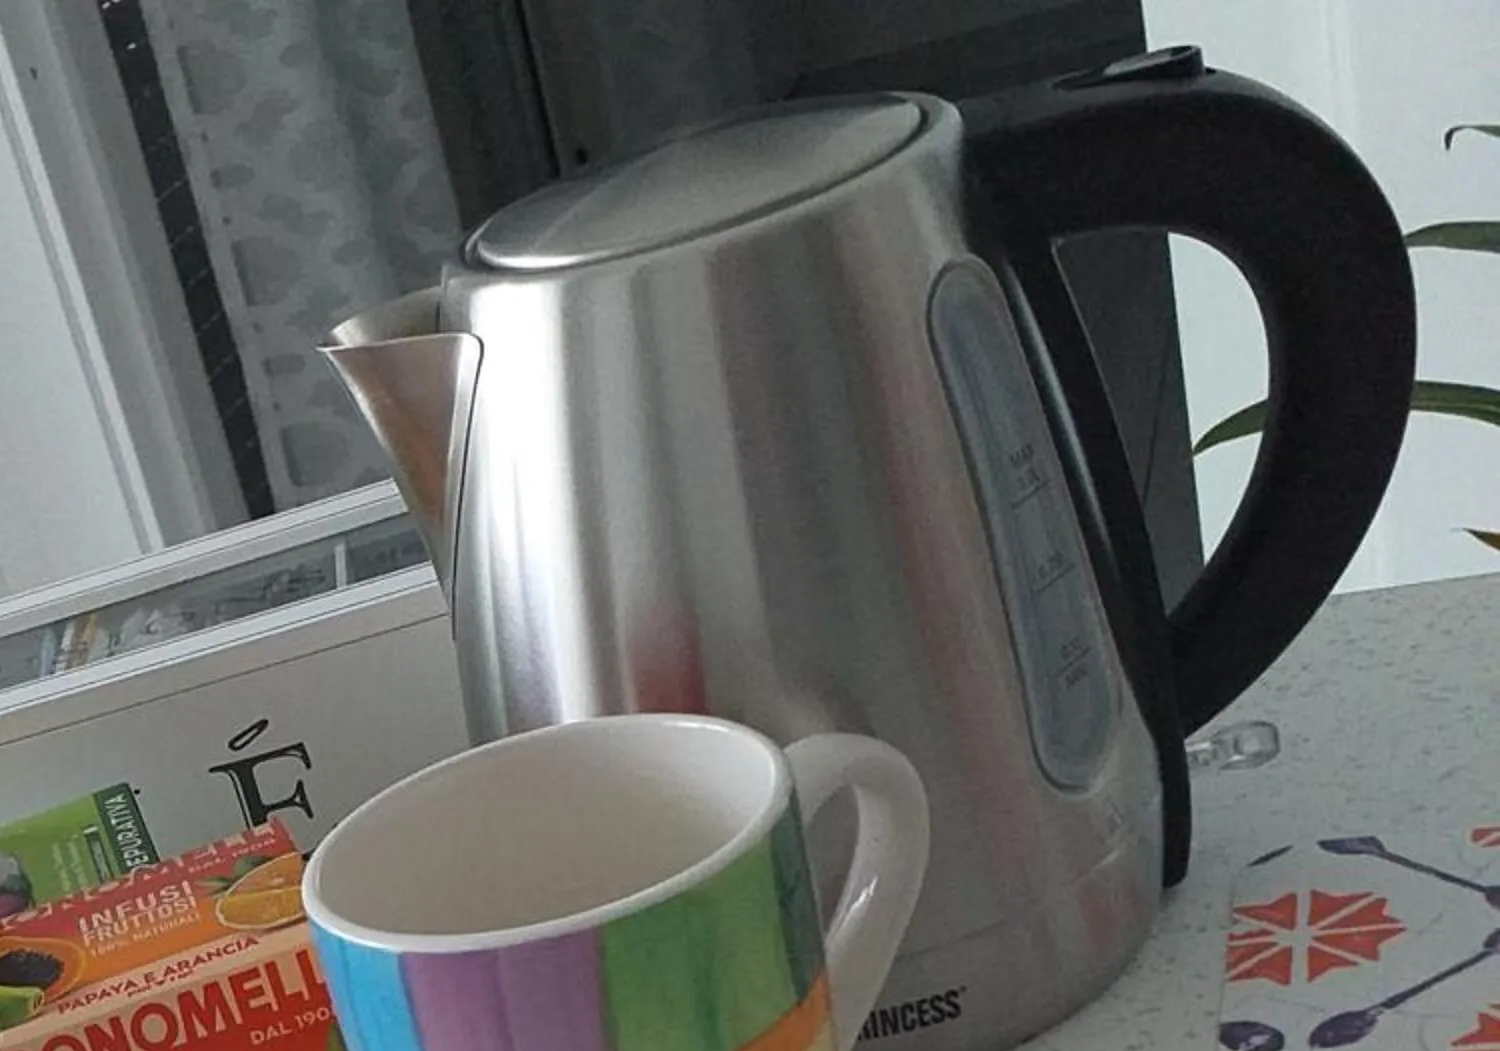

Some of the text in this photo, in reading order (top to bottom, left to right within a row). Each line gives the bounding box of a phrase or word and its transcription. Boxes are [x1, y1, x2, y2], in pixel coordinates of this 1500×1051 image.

[104, 793, 150, 867] EPURATIVA
[78, 880, 194, 931] INFUSI
[82, 895, 197, 947] FRUTTOSI
[57, 978, 141, 1014] PAPAYA
[162, 936, 260, 976] ARANCIA
[249, 1007, 331, 1045] DAL 190
[858, 990, 962, 1041] INCESS
